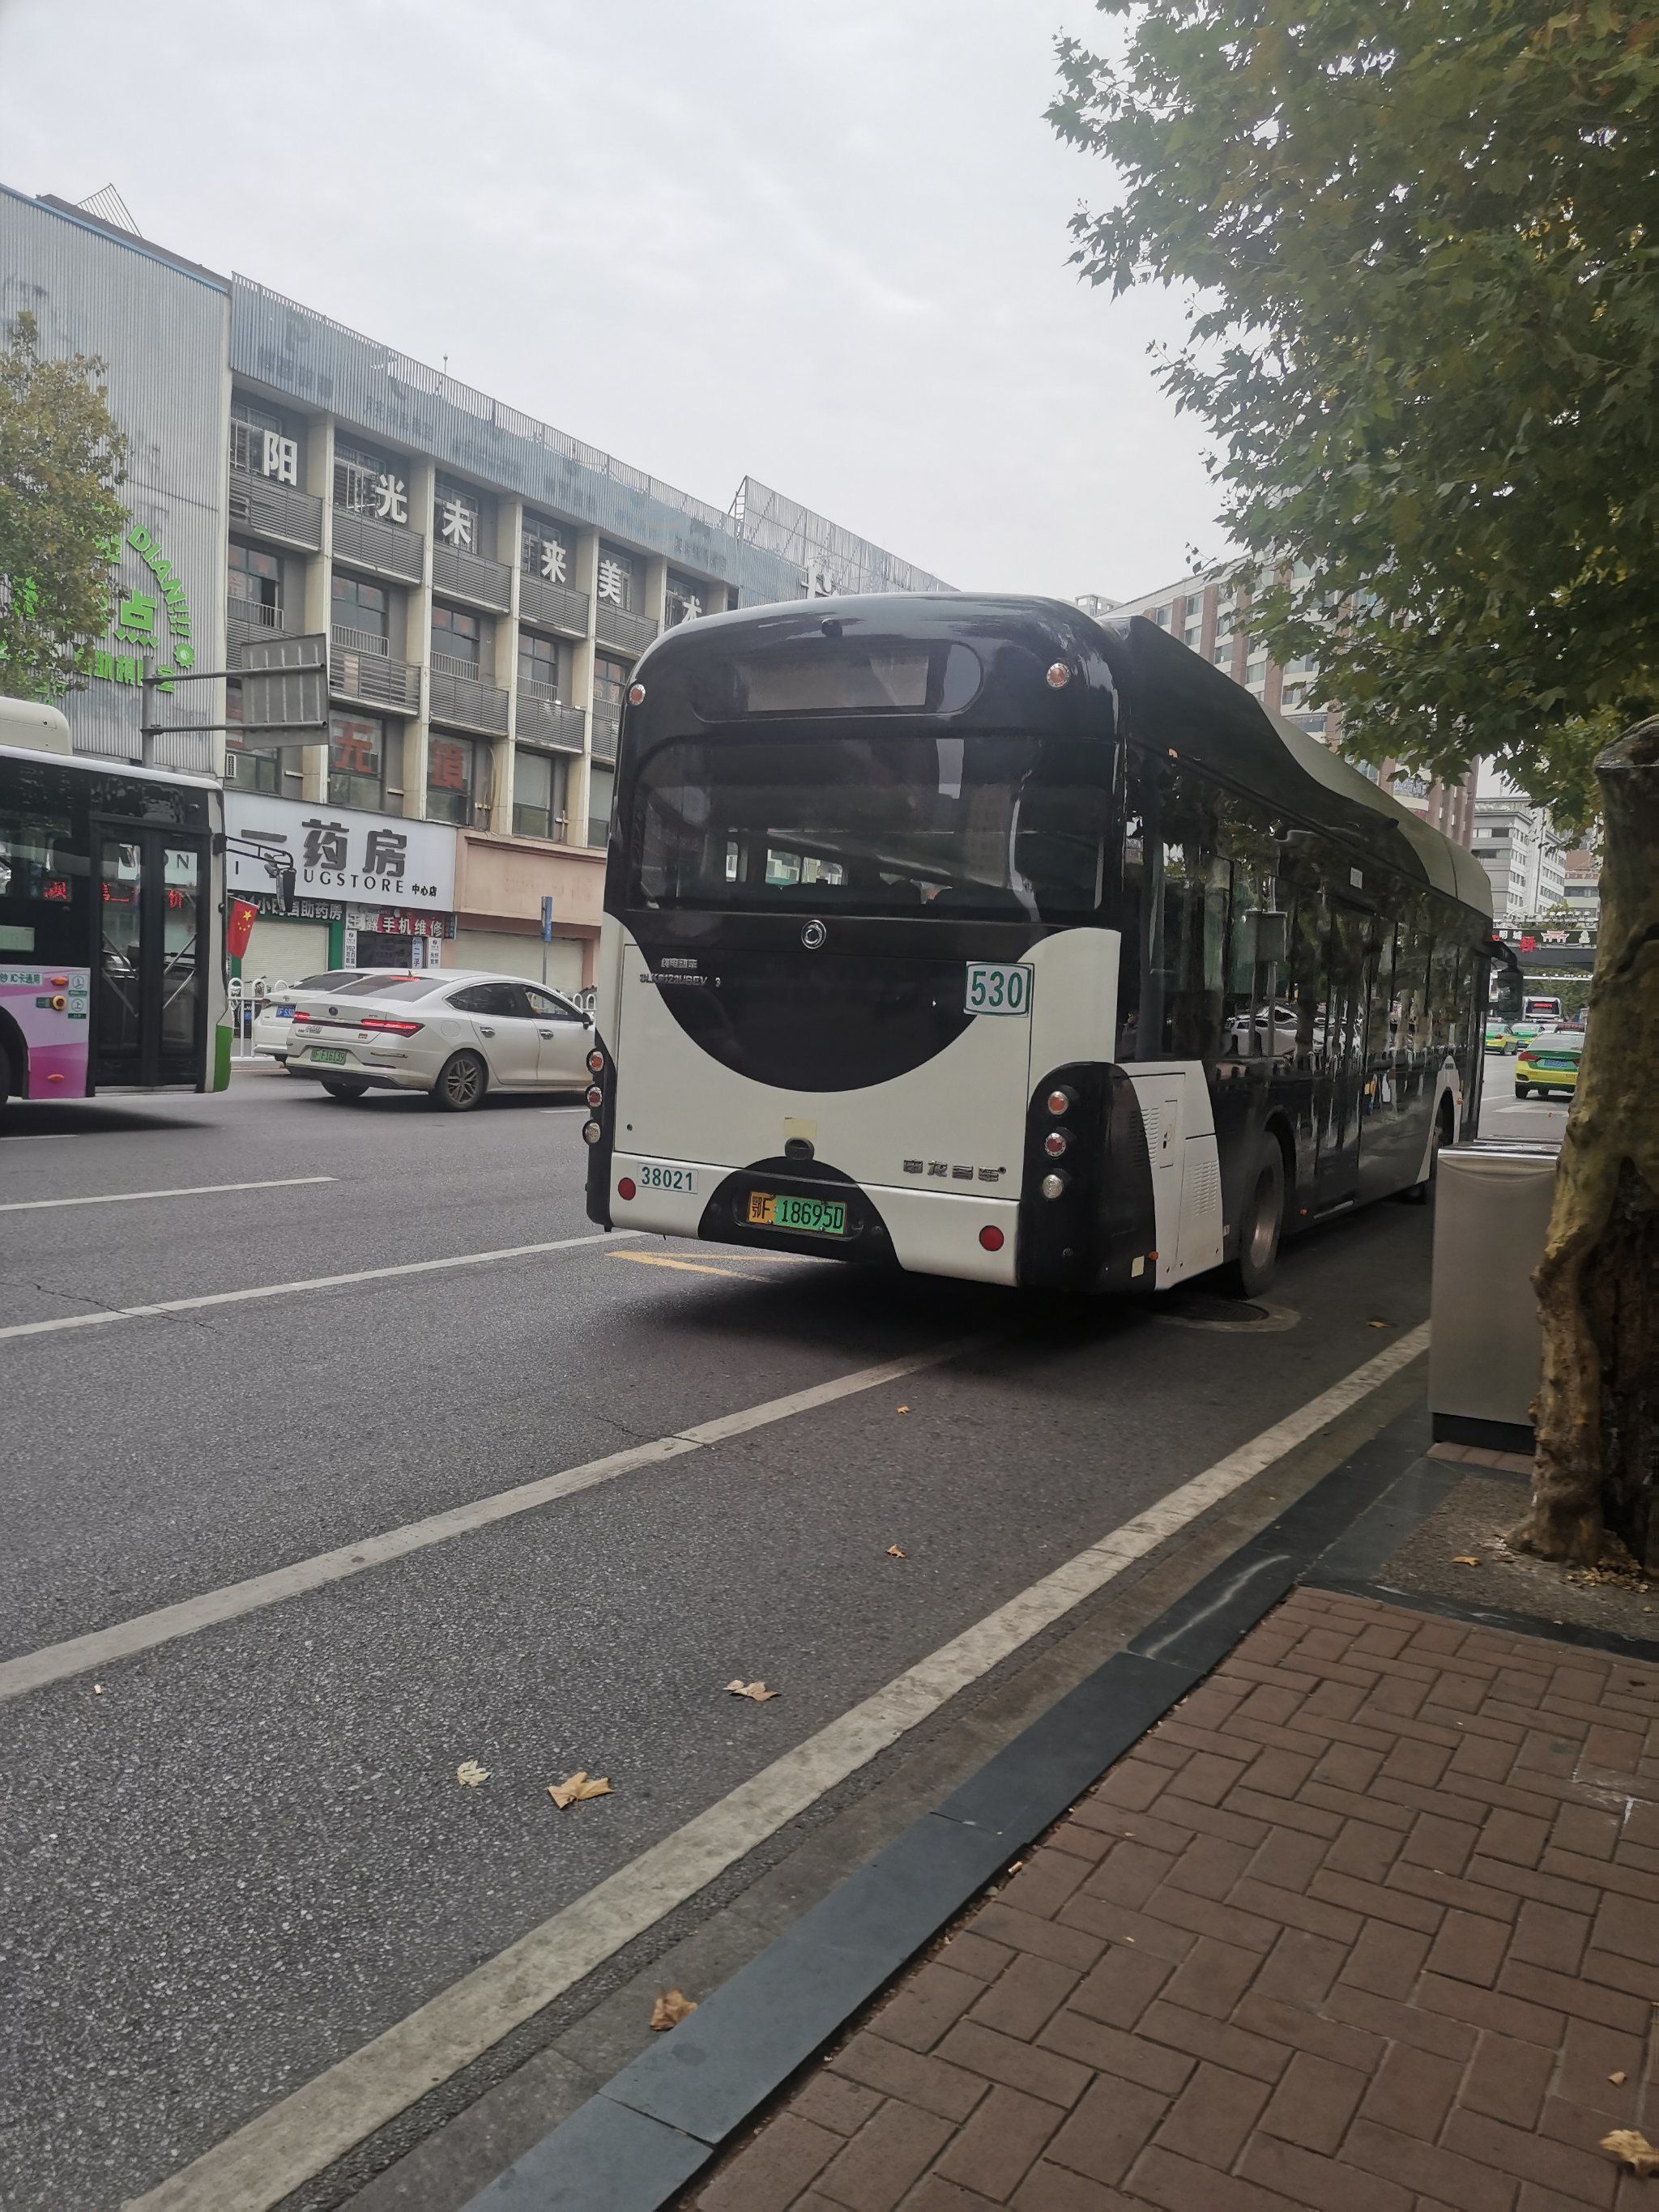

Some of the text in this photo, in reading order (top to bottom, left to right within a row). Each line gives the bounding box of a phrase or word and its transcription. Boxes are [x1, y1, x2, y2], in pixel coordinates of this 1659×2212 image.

[304, 869, 403, 893] UGSTORE
[412, 883, 437, 897] 中心店
[971, 971, 1023, 1008] 530
[641, 1166, 693, 1191] 38021
